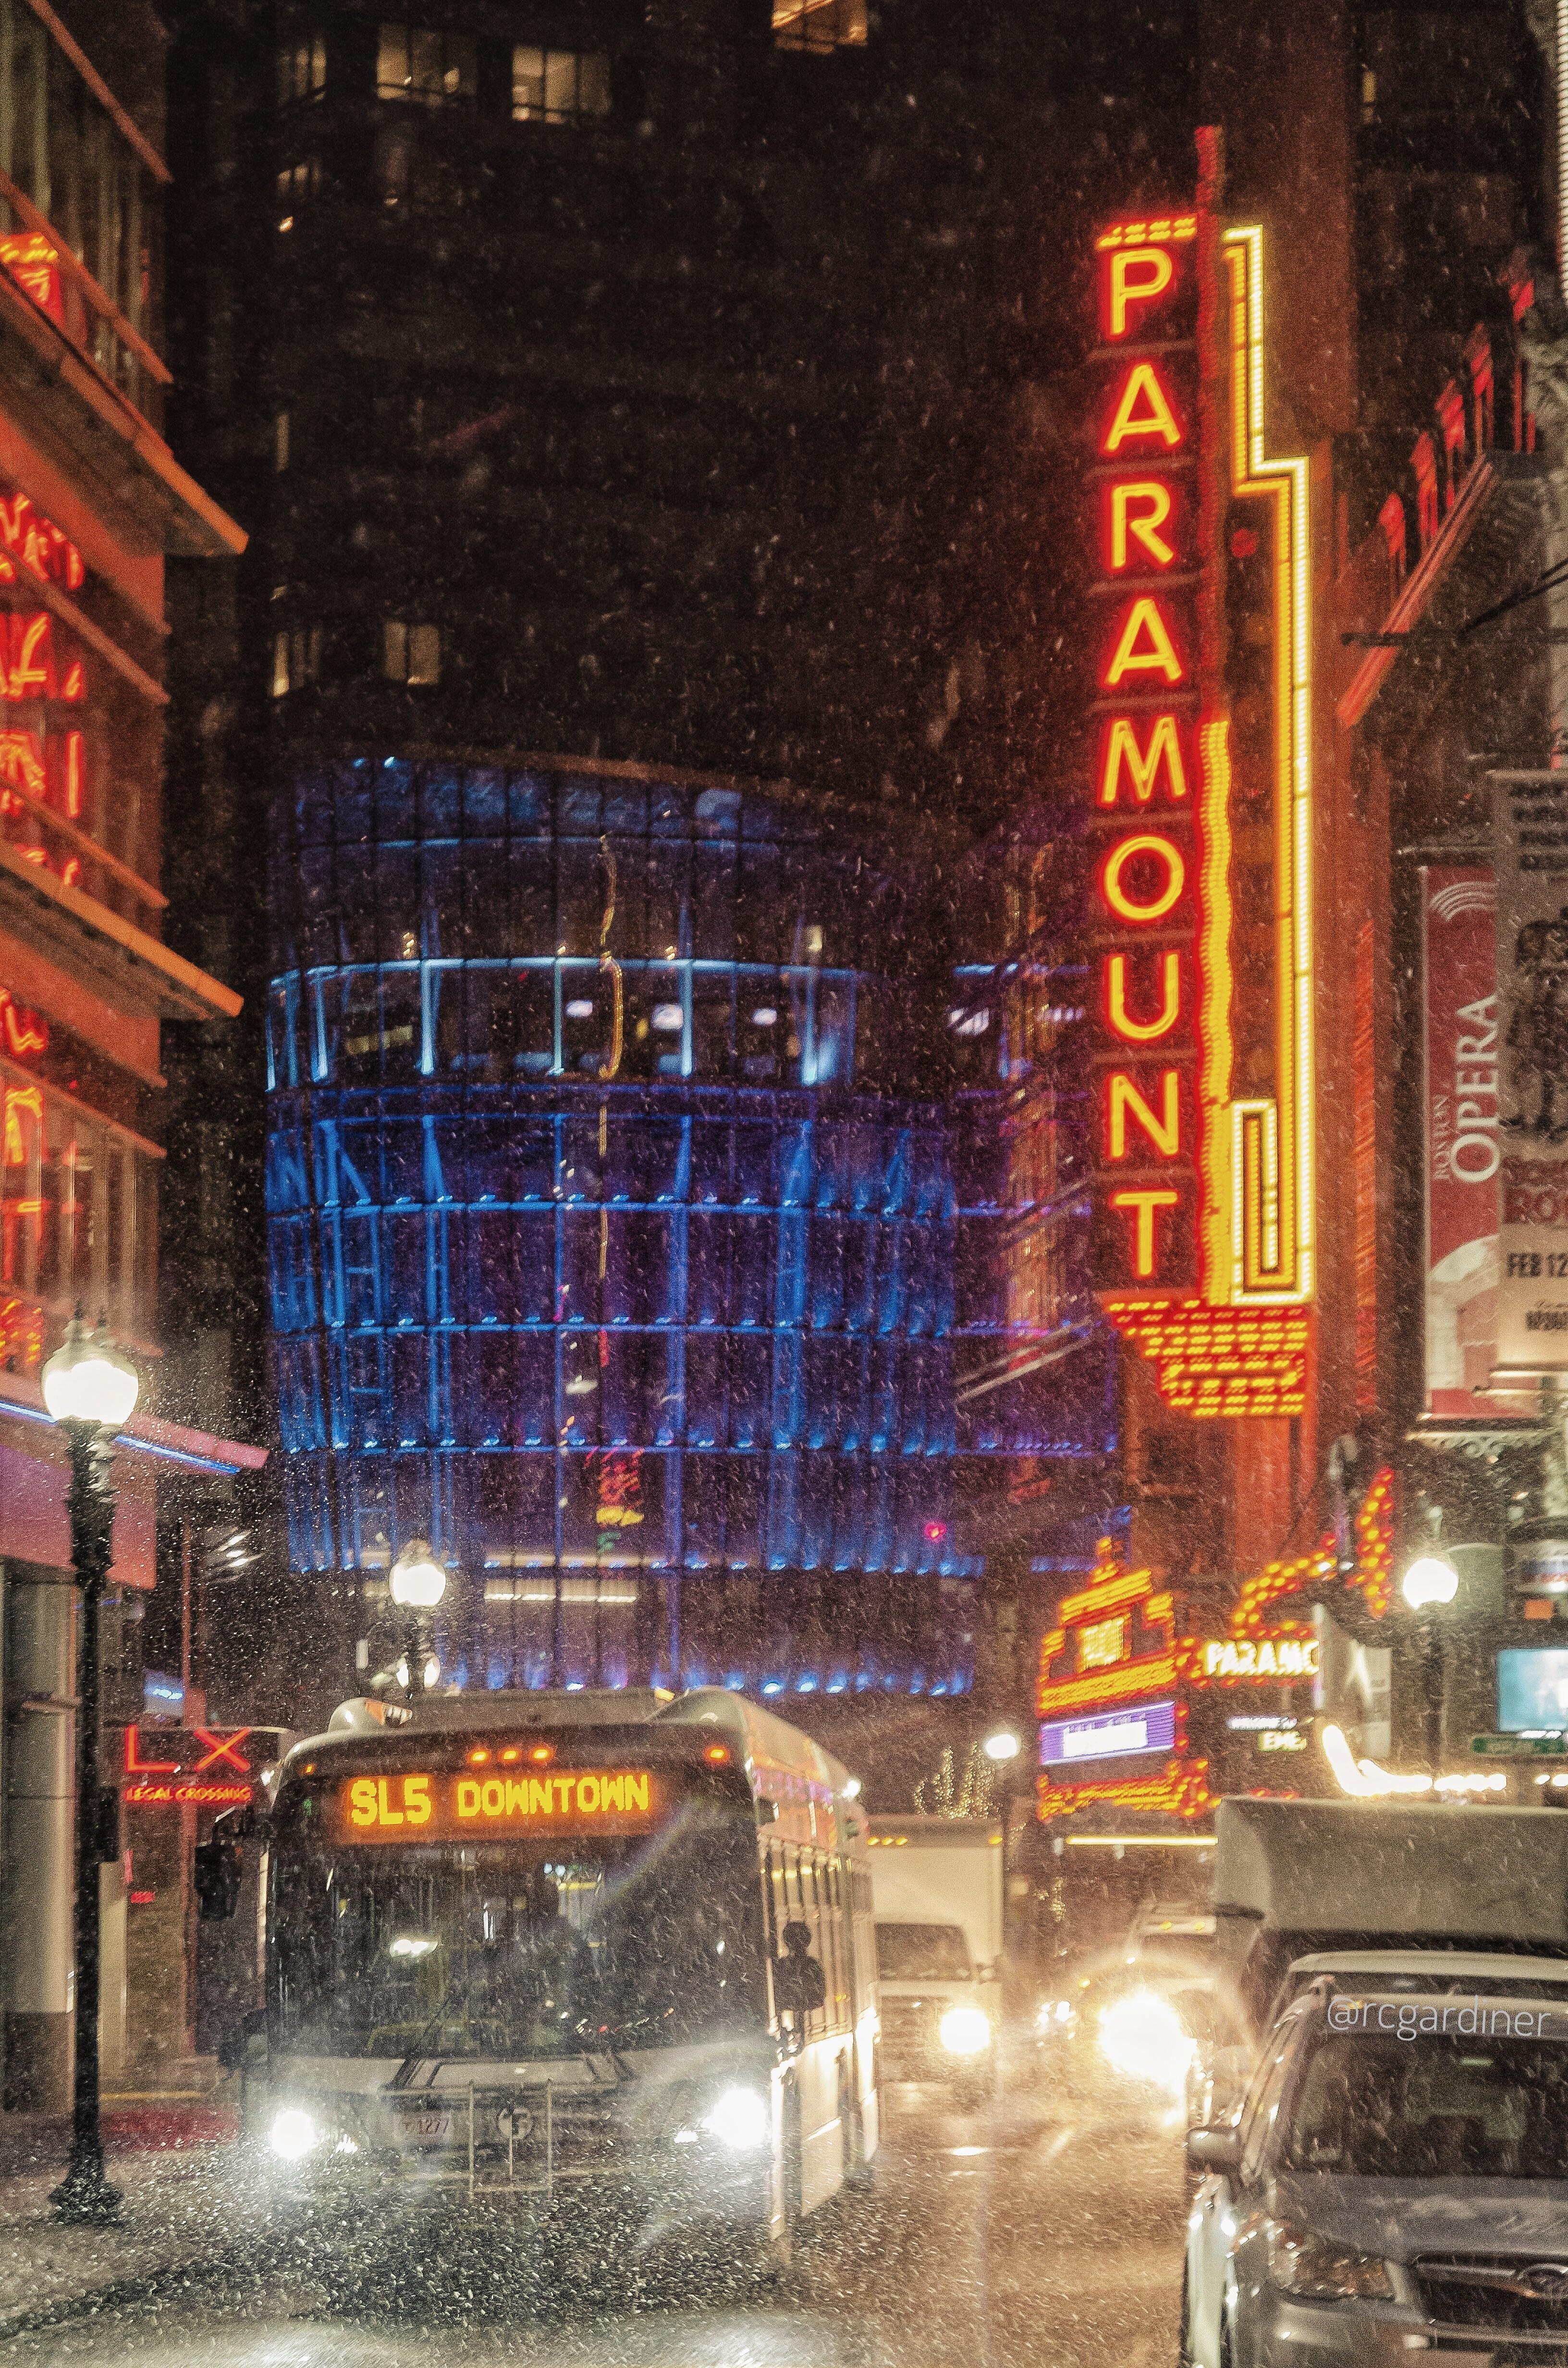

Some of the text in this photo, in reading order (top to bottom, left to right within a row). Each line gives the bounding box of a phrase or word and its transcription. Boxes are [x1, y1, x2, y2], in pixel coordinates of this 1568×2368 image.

[1102, 247, 1189, 1279] PARAMOUNT
[1450, 992, 1501, 1184] OPERA
[1505, 1188, 1568, 1224] RO
[1507, 1252, 1542, 1278] FEB
[126, 1786, 252, 1801] LEGAL CROSSING
[350, 1774, 649, 1826] SL5 DOWNTOWN
